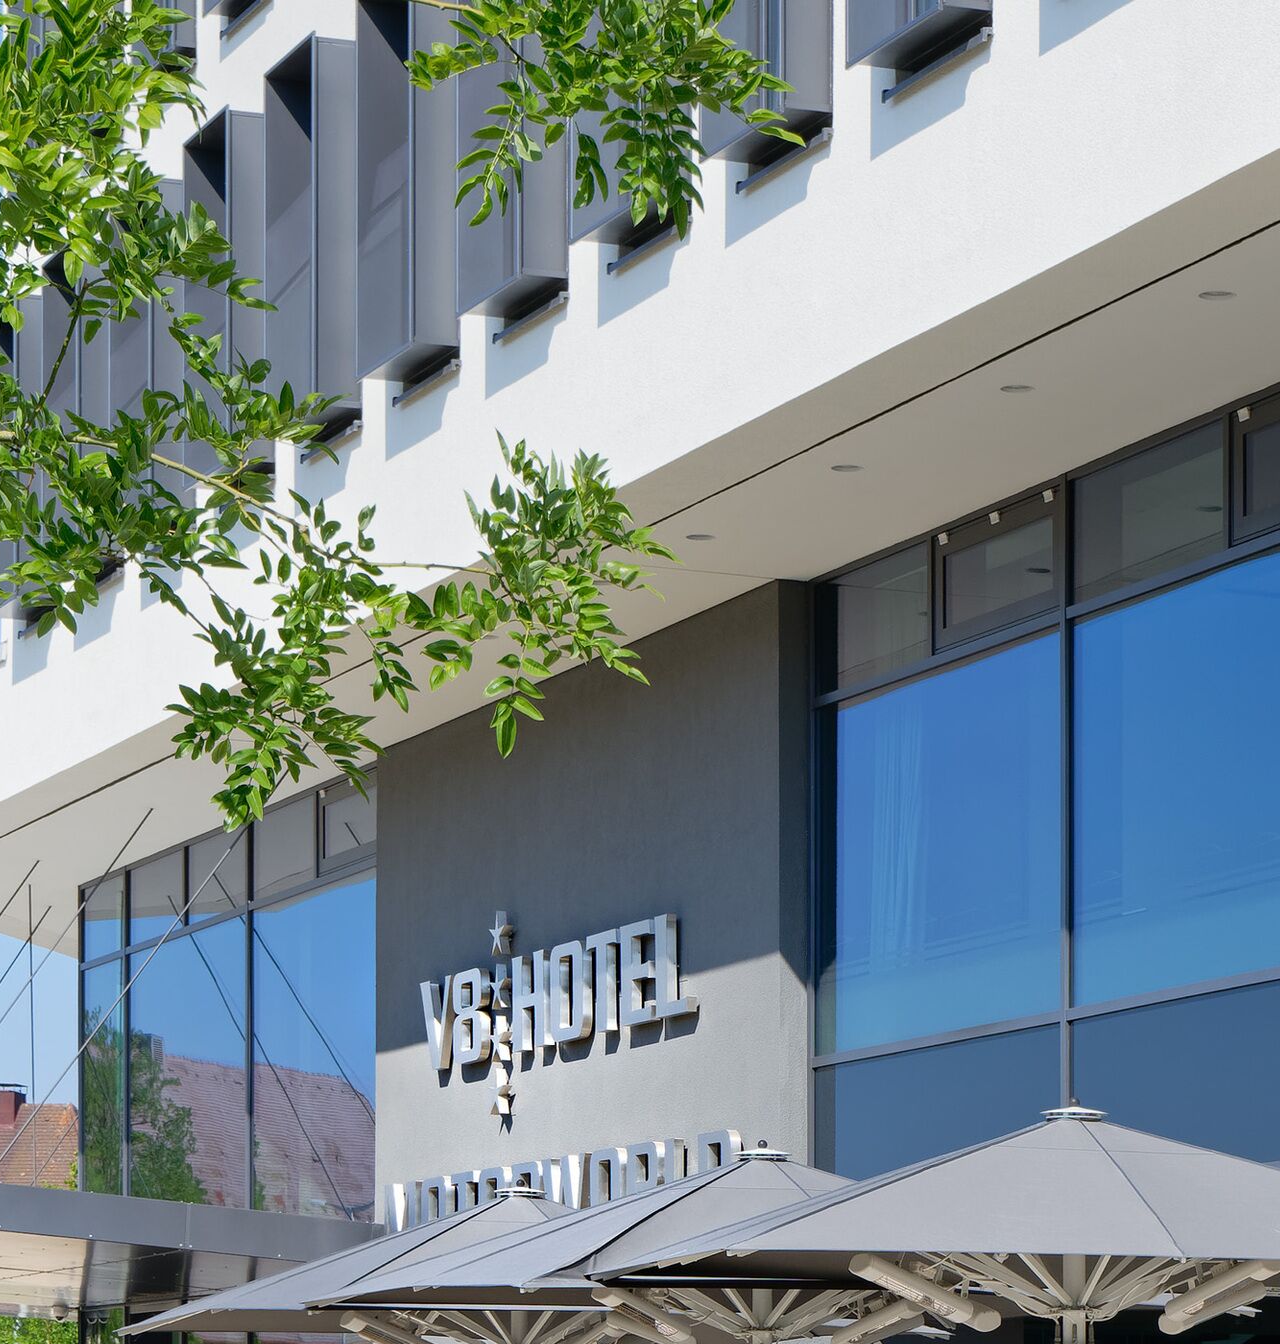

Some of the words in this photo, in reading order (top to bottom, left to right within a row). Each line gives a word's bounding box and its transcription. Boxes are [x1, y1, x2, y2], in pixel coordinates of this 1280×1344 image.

[420, 967, 490, 1071] V8
[511, 913, 699, 1052] HOTEL
[384, 1129, 742, 1235] MOTWORD
